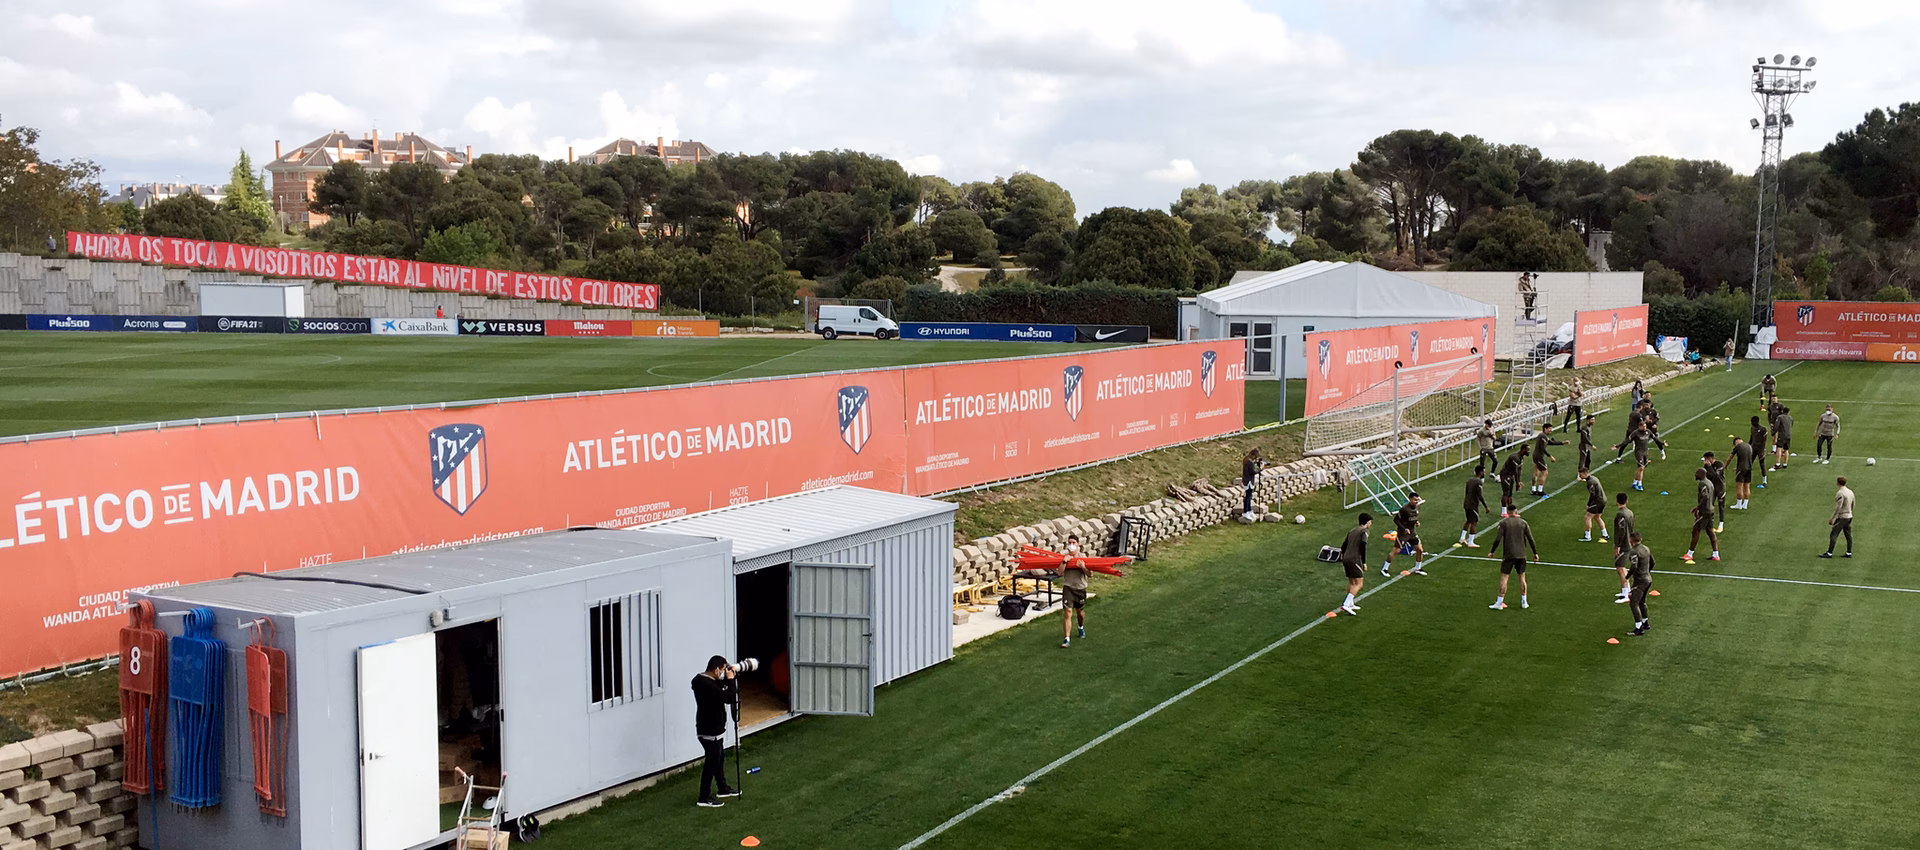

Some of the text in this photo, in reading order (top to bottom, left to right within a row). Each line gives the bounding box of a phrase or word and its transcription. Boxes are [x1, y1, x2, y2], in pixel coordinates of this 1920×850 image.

[75, 233, 131, 260] AHORA
[140, 236, 164, 263] OS
[171, 239, 217, 267] TOCA
[225, 244, 236, 269] A
[241, 245, 337, 278] VOSOTROS
[344, 255, 400, 284] ESTAR
[404, 260, 427, 288] AL
[486, 271, 508, 296] DE
[515, 272, 573, 302] ESTOS
[579, 280, 656, 310] COLORES
[49, 317, 90, 328] Plus500
[123, 318, 160, 329] Acronis
[1838, 311, 1887, 322] ATLÉTICO
[398, 320, 449, 332] CaixaBank
[489, 322, 542, 332] VERSUS
[573, 321, 605, 330] Mahou
[656, 321, 677, 335] ria
[1010, 327, 1052, 339] Plus500
[1893, 345, 1917, 360] ria
[1225, 359, 1245, 381] ATLÉ
[1096, 374, 1145, 401] ATLÉTICO
[1154, 368, 1193, 391] MADRID
[915, 387, 1052, 425] ATLÉTICO DE MADRID
[563, 416, 792, 473] ATLÉTICO DE MADRID
[801, 469, 874, 491] atleticodemadrid.com
[164, 493, 191, 515] DE
[200, 466, 360, 520] MADRID
[729, 486, 749, 497] HAZTE
[615, 501, 671, 517] CIUDAD DEPORTIVA
[622, 513, 652, 527] ATLÉTICO
[653, 512, 662, 521] DE
[662, 507, 687, 520] MADRID
[299, 553, 332, 569] HAZTE
[79, 591, 121, 607] CIUDAD
[43, 609, 90, 628] WANDA
[129, 646, 141, 676] 8
